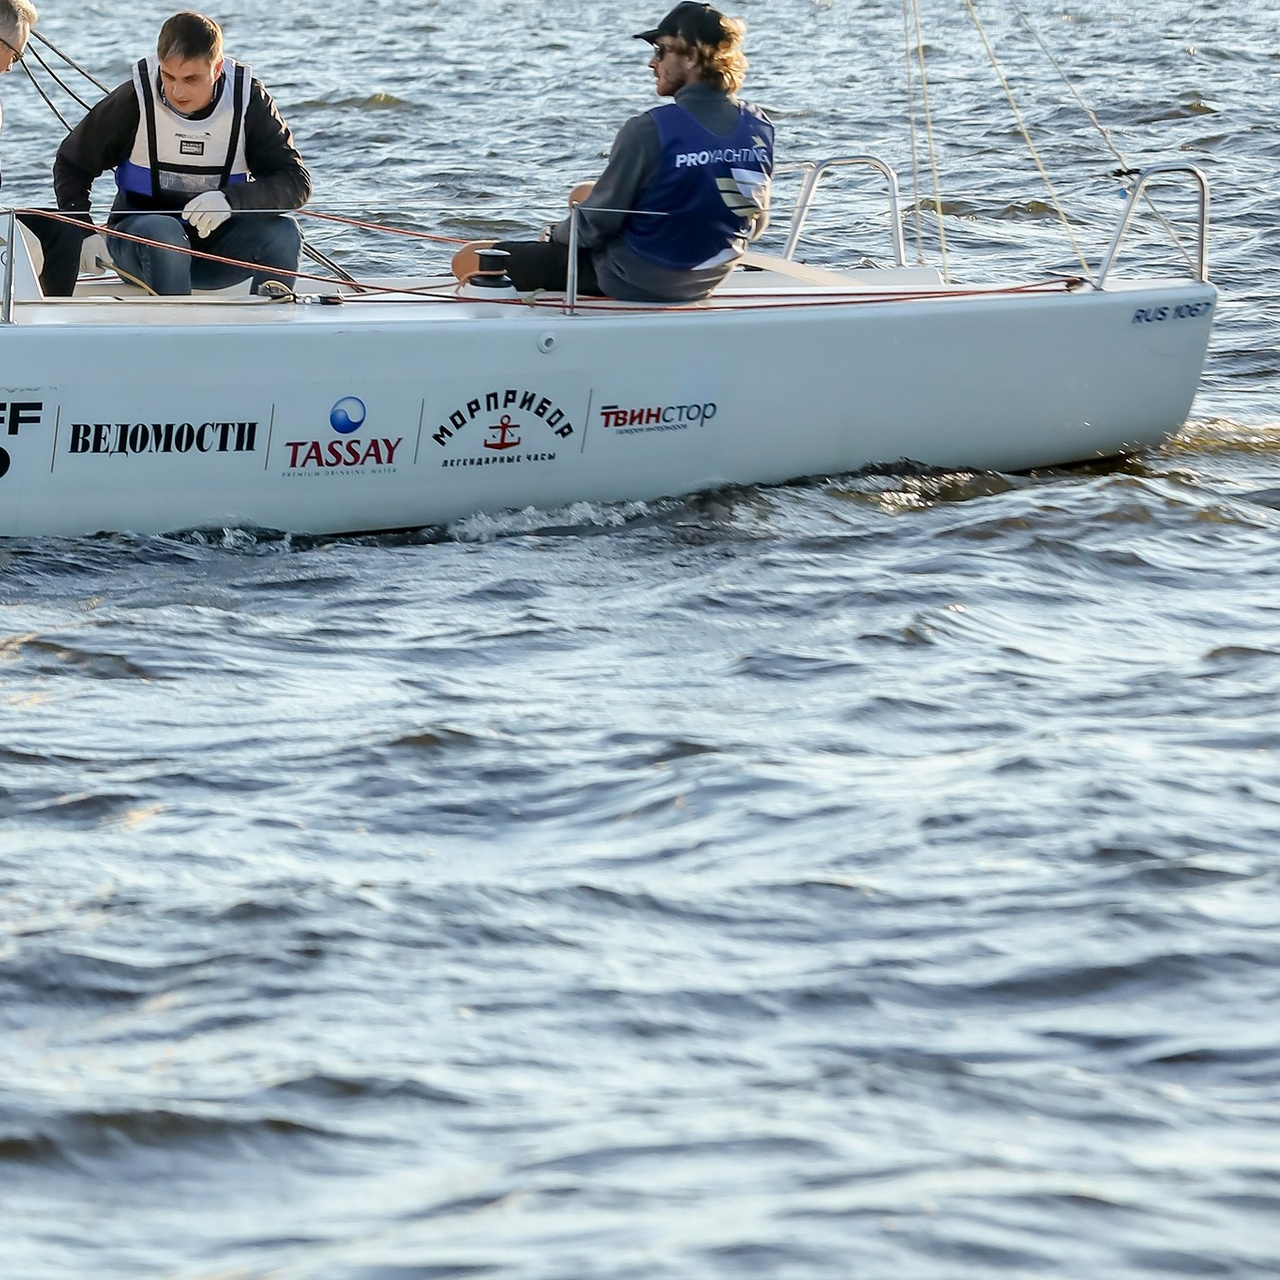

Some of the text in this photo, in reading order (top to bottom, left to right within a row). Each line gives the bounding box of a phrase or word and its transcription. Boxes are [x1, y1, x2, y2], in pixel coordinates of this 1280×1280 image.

[675, 147, 768, 168] PROYACHTING
[1131, 306, 1169, 324] RUS
[431, 389, 574, 447] МОРПРИБОР
[67, 421, 259, 458] ВЕДОМОСТИ
[284, 437, 404, 468] TASSAY
[441, 452, 556, 468] ЛЕГЕНДАРНЫЕ ЧАСЫ
